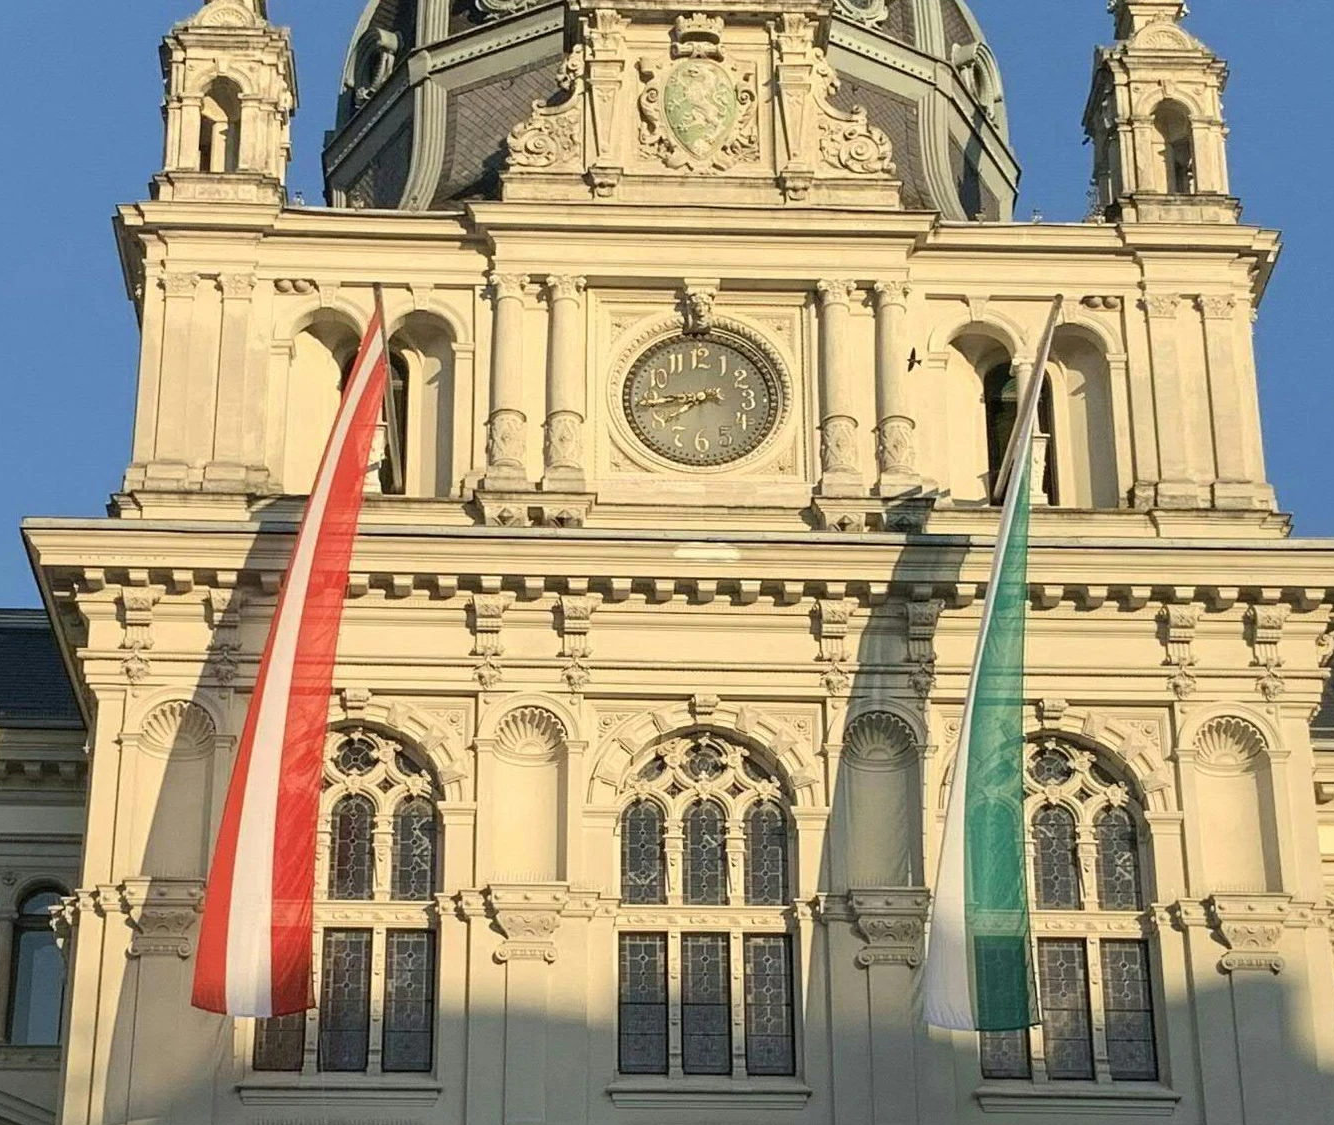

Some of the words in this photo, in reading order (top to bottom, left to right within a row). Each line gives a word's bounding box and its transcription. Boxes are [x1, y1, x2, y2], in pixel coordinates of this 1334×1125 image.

[669, 353, 683, 374] 11
[690, 348, 711, 369] 12
[719, 355, 727, 376] 1
[650, 368, 667, 389] 10
[733, 369, 749, 389] 2
[742, 389, 756, 410] 3
[736, 412, 755, 431] 4
[672, 426, 686, 448] 7
[695, 428, 709, 453] 6
[718, 425, 733, 447] 5
